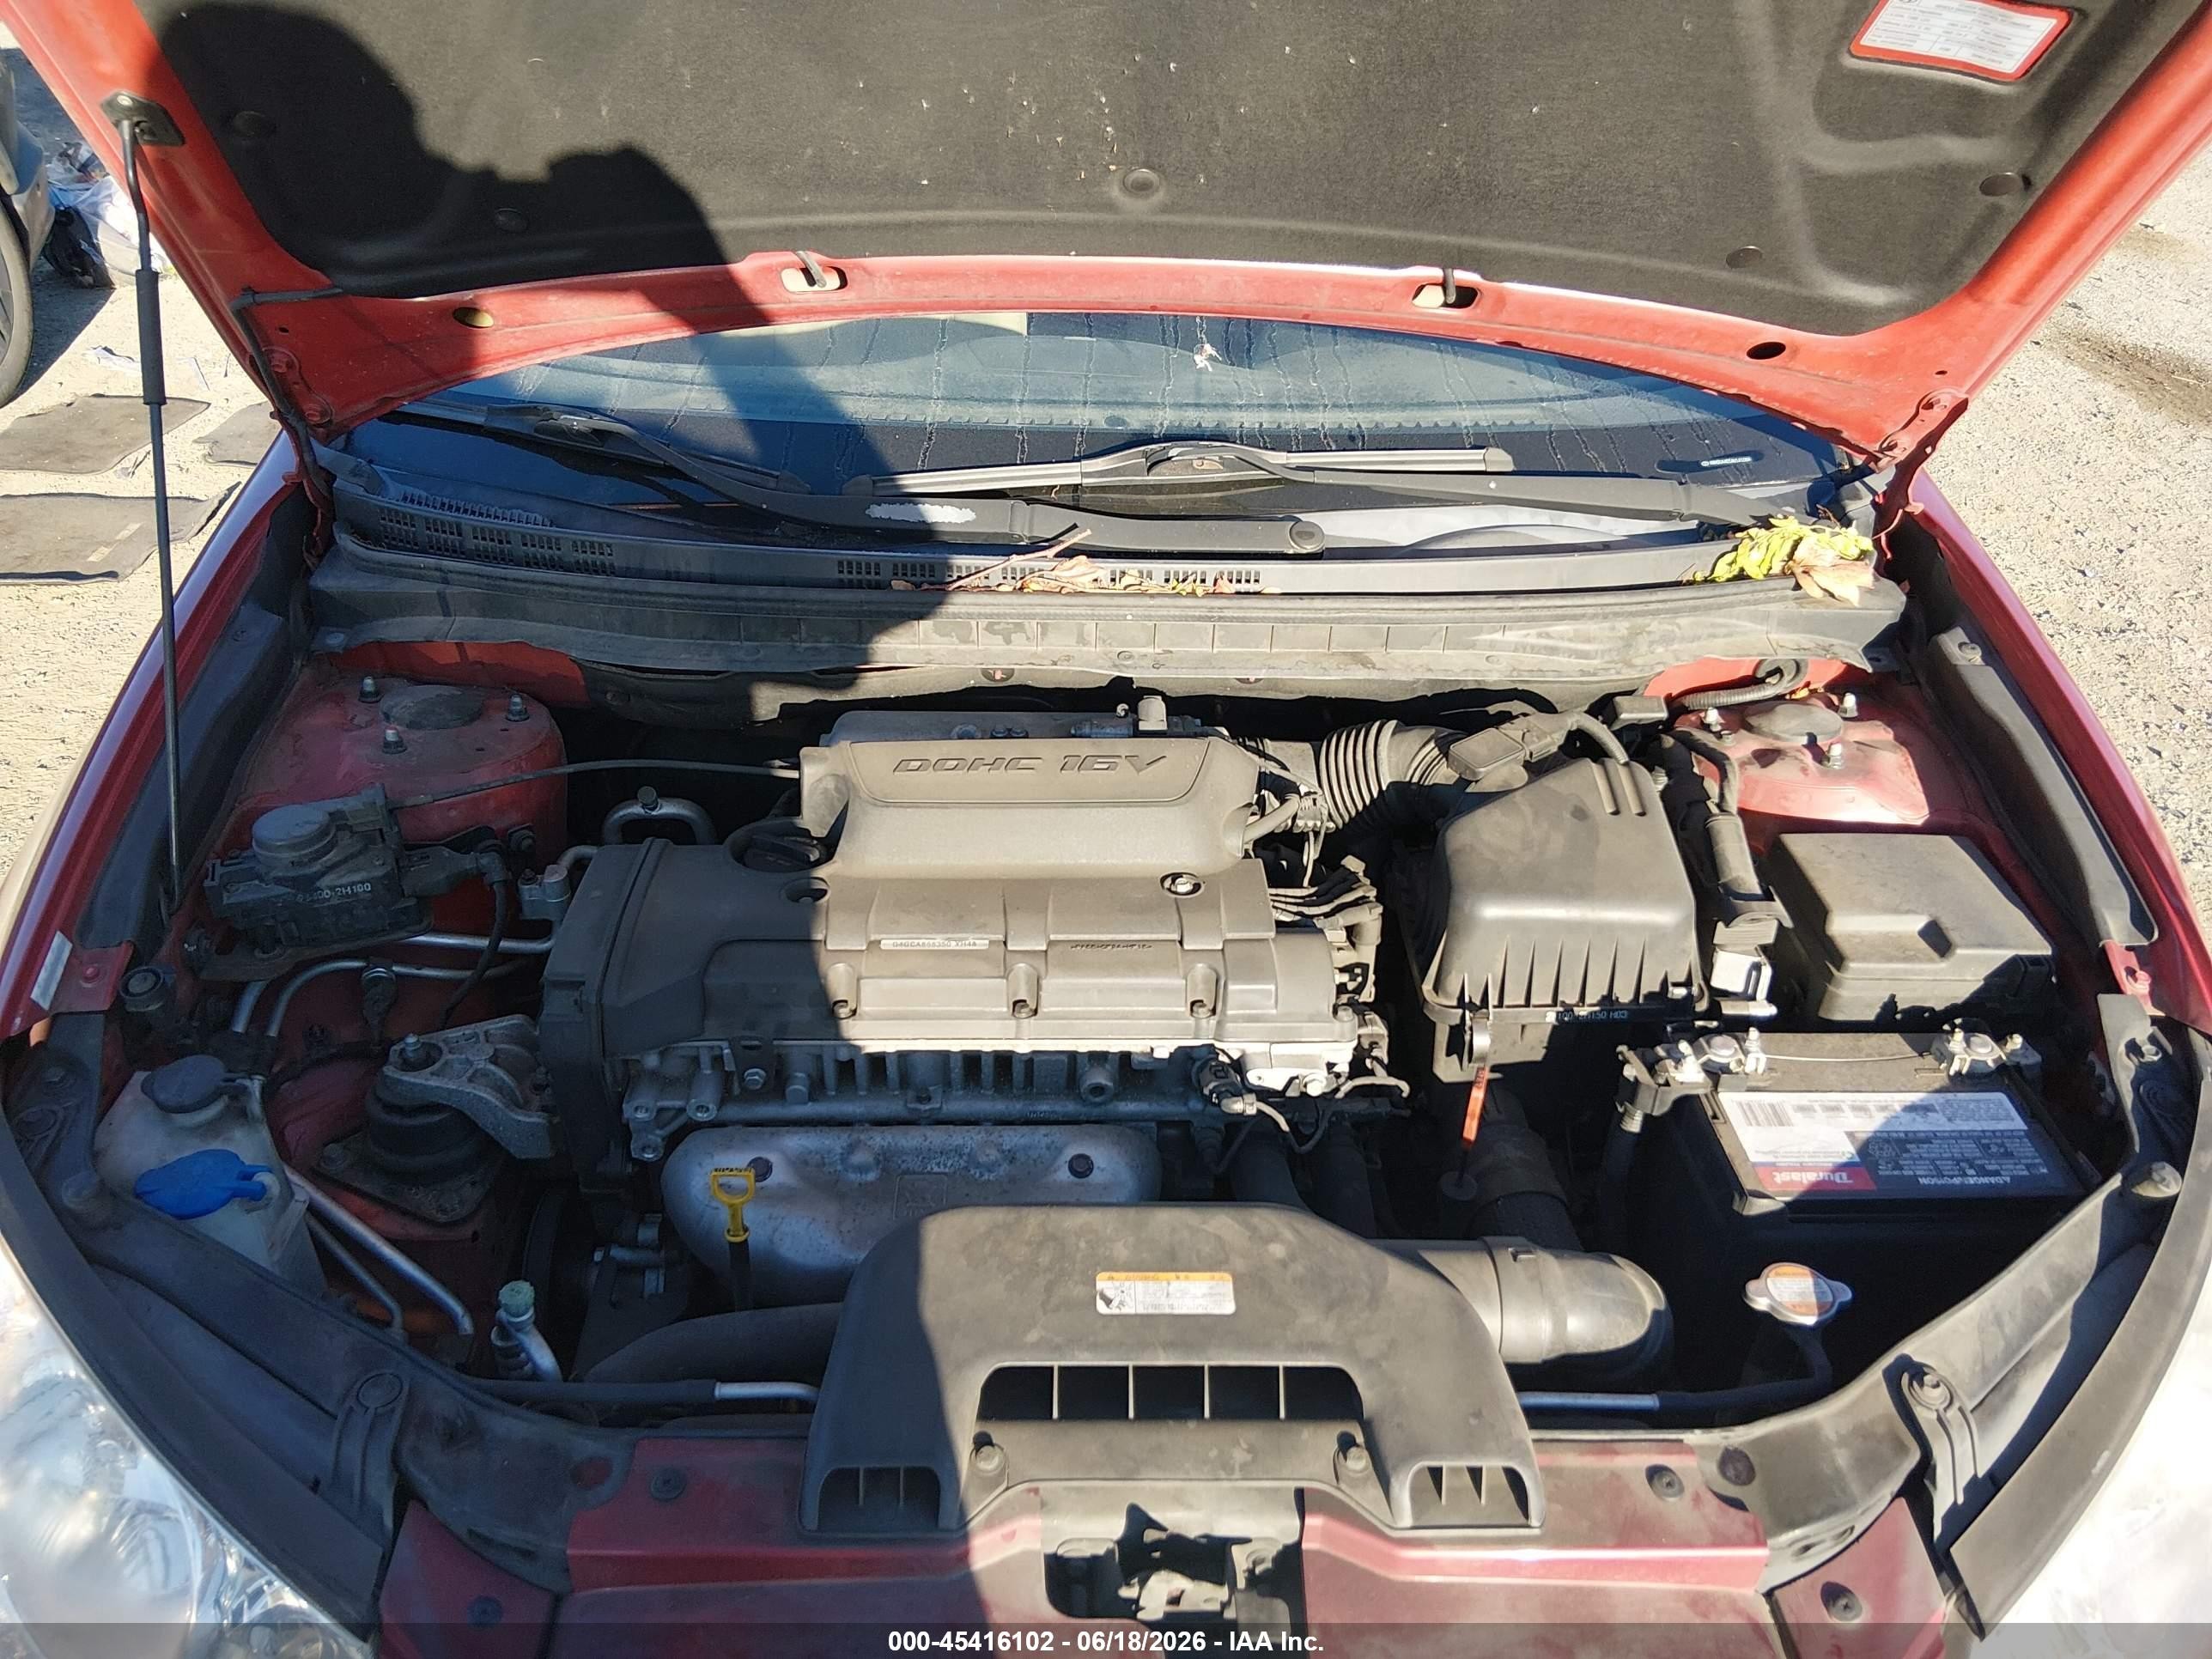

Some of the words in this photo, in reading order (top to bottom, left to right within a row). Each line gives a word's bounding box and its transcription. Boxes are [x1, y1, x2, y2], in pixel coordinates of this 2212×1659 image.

[893, 757, 1043, 774] DOHC
[1060, 755, 1167, 775] 16V
[1772, 1171, 1853, 1184] Duralast
